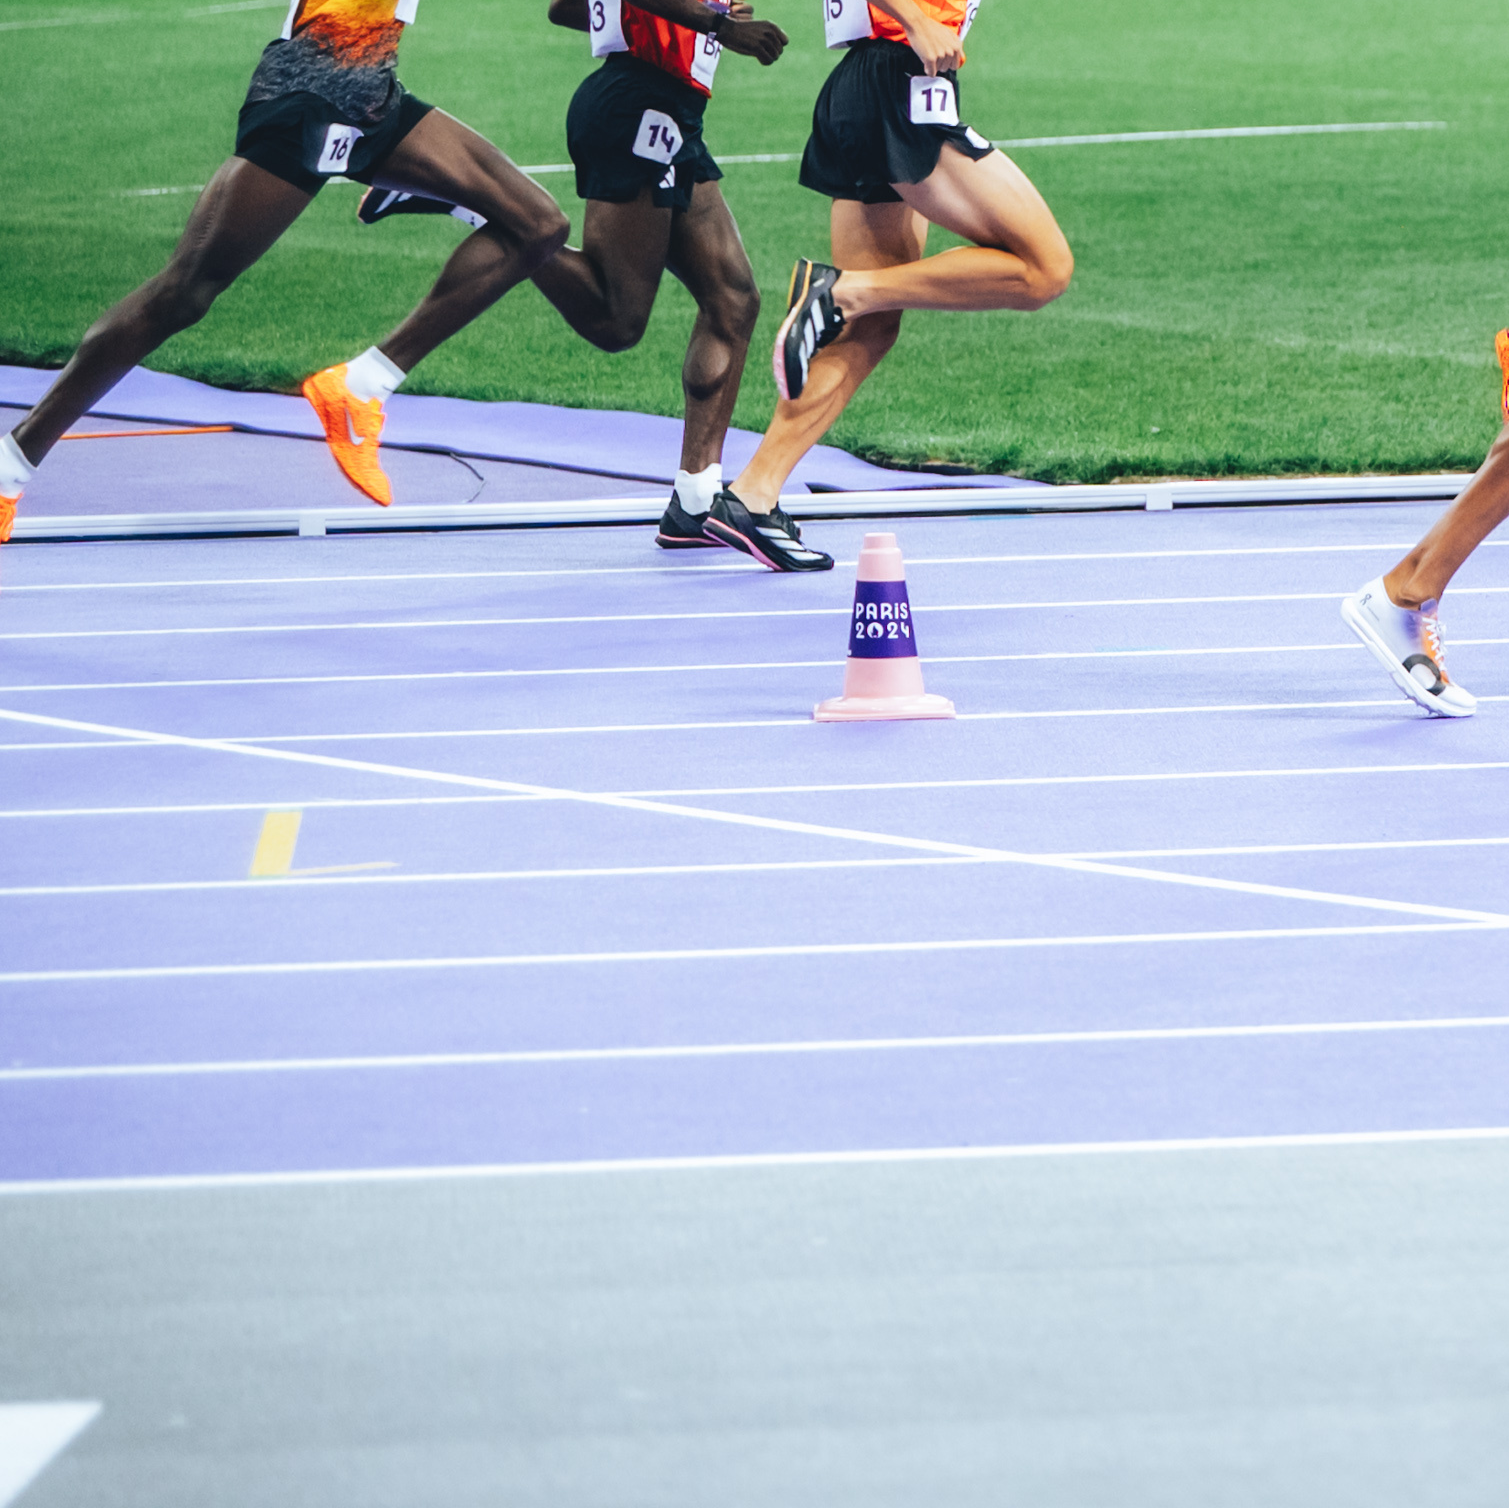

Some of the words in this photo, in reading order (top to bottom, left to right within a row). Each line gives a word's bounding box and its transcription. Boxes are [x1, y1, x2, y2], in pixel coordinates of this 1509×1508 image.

[921, 88, 948, 112] 17
[329, 138, 348, 161] 16
[648, 124, 675, 153] 14
[855, 602, 909, 620] PARIS
[855, 621, 910, 639] 2024
